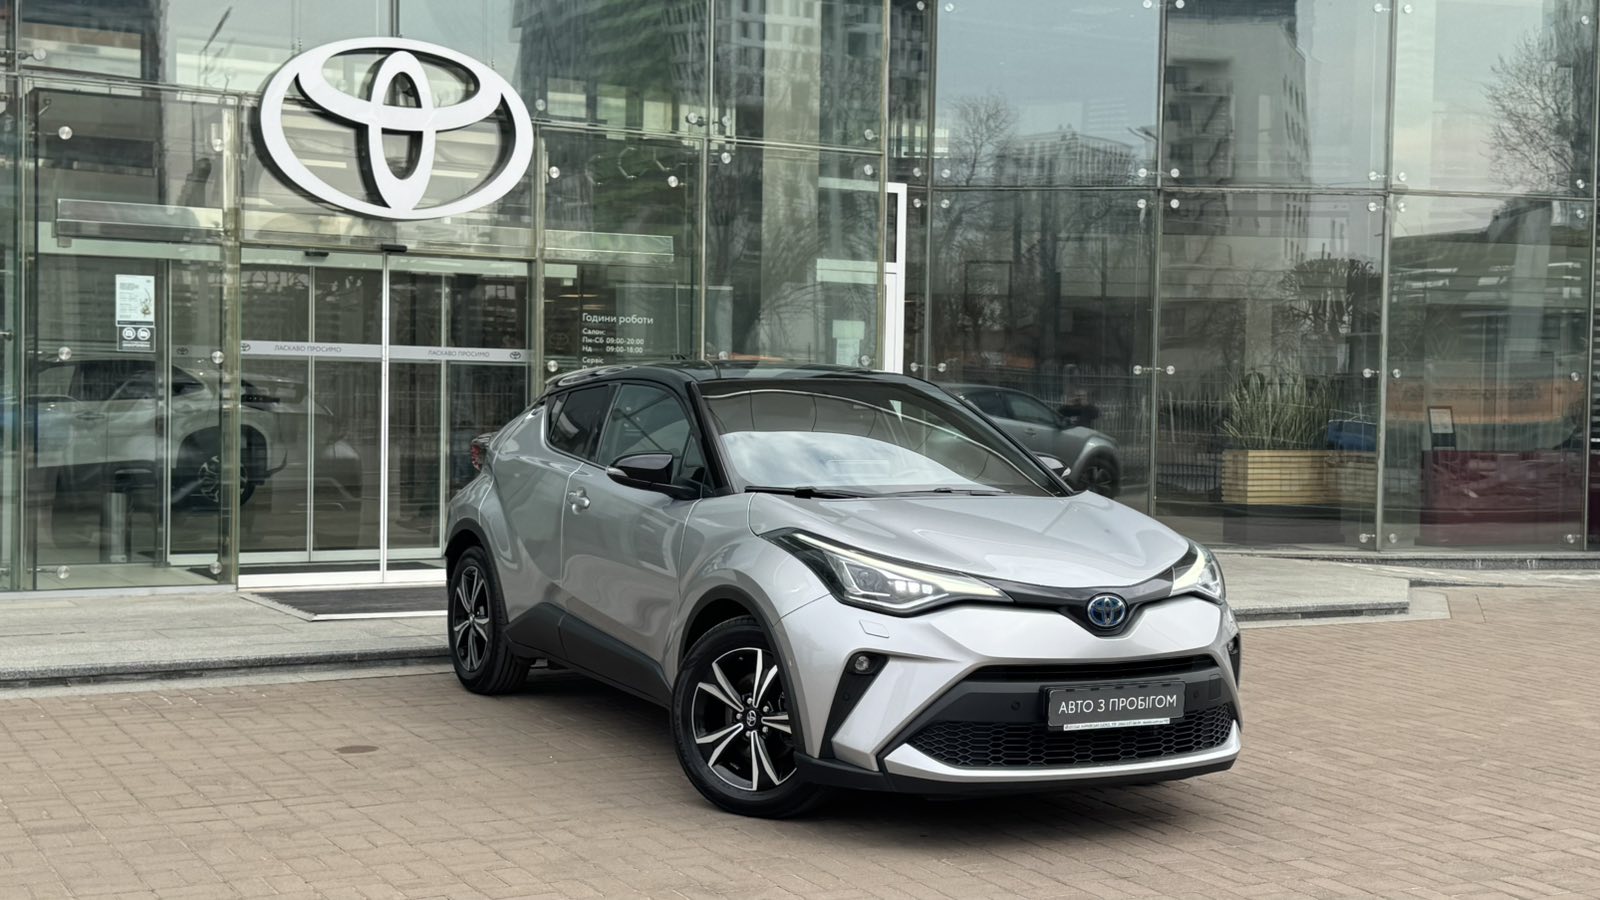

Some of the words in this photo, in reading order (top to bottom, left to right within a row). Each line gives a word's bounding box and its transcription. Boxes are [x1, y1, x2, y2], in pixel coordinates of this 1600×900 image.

[582, 312, 617, 323] Години
[618, 314, 654, 325] роботи
[582, 336, 605, 344] Пн-Сб
[274, 344, 306, 352] ЛАСКАВО
[307, 345, 342, 353] ПРОСИМО
[458, 350, 490, 358] ПРОСИМО
[1058, 699, 1094, 714] АВТО
[1109, 694, 1177, 711] ПРОБІГОМ
